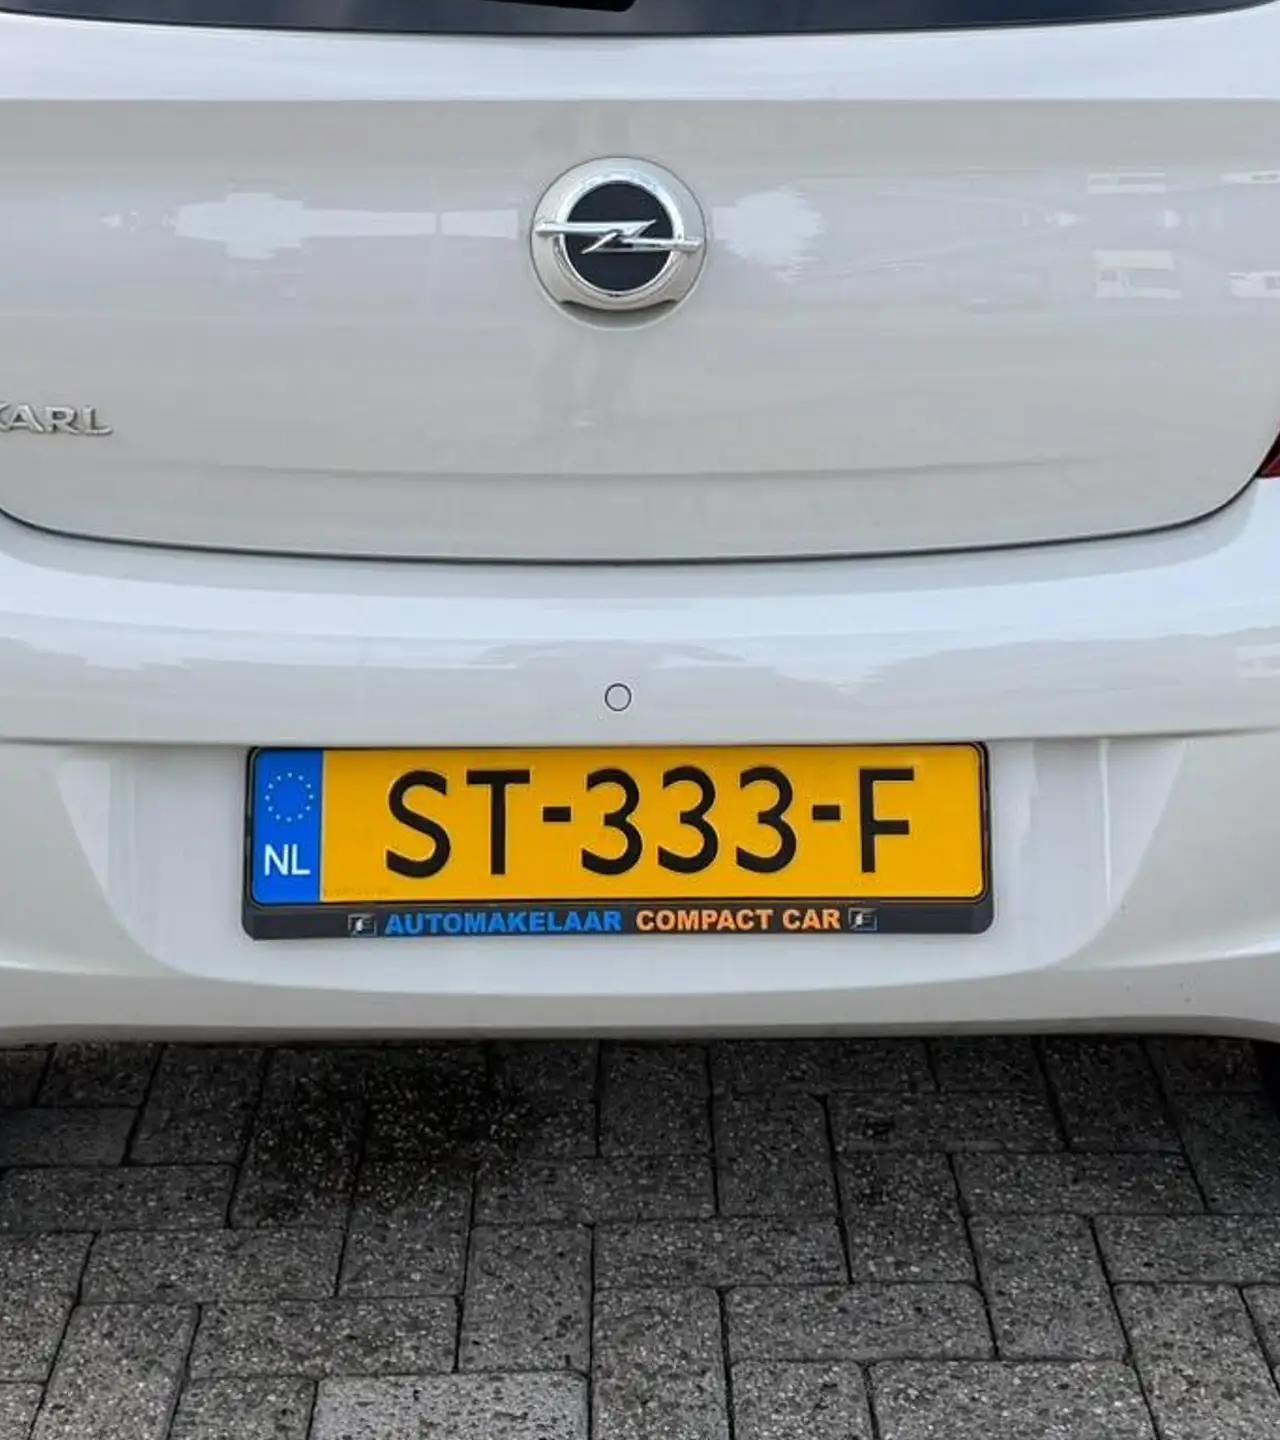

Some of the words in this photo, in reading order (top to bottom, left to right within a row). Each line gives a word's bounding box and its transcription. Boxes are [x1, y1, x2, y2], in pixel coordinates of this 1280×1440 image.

[264, 843, 311, 877] NL
[385, 766, 916, 879] ST-333-F
[384, 911, 622, 936] AUTOMAKELAAR
[636, 909, 773, 931] COMPACT
[782, 907, 841, 930] CAR
